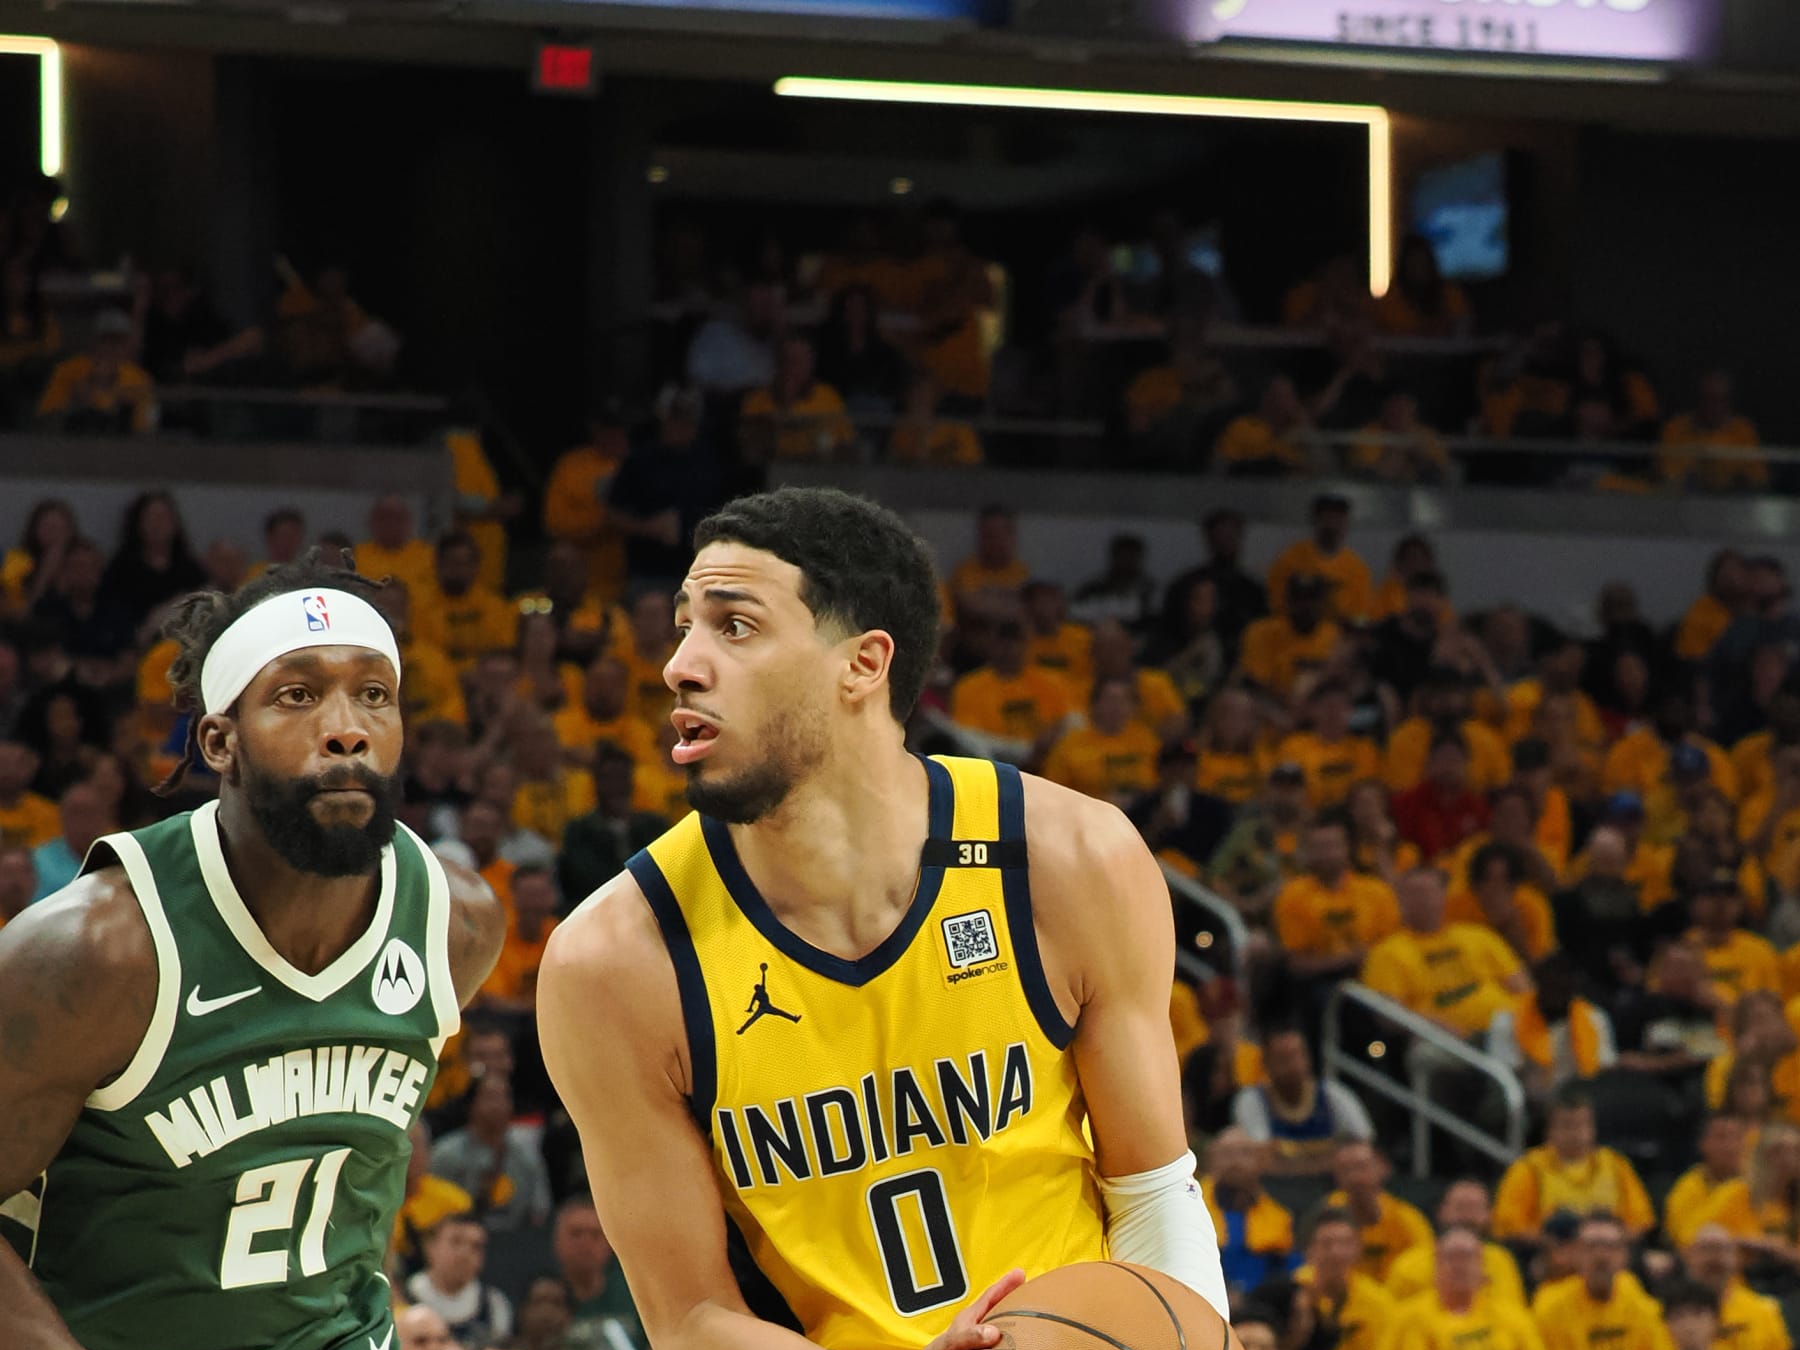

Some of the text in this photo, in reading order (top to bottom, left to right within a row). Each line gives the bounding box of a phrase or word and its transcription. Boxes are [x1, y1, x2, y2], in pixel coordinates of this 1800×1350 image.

[958, 843, 988, 865] 30
[946, 961, 1009, 985] spokenote
[144, 1044, 428, 1169] MILWAUKEE
[717, 1040, 1034, 1189] INDIANA
[221, 1148, 353, 1291] 21
[865, 1166, 971, 1318] 0
